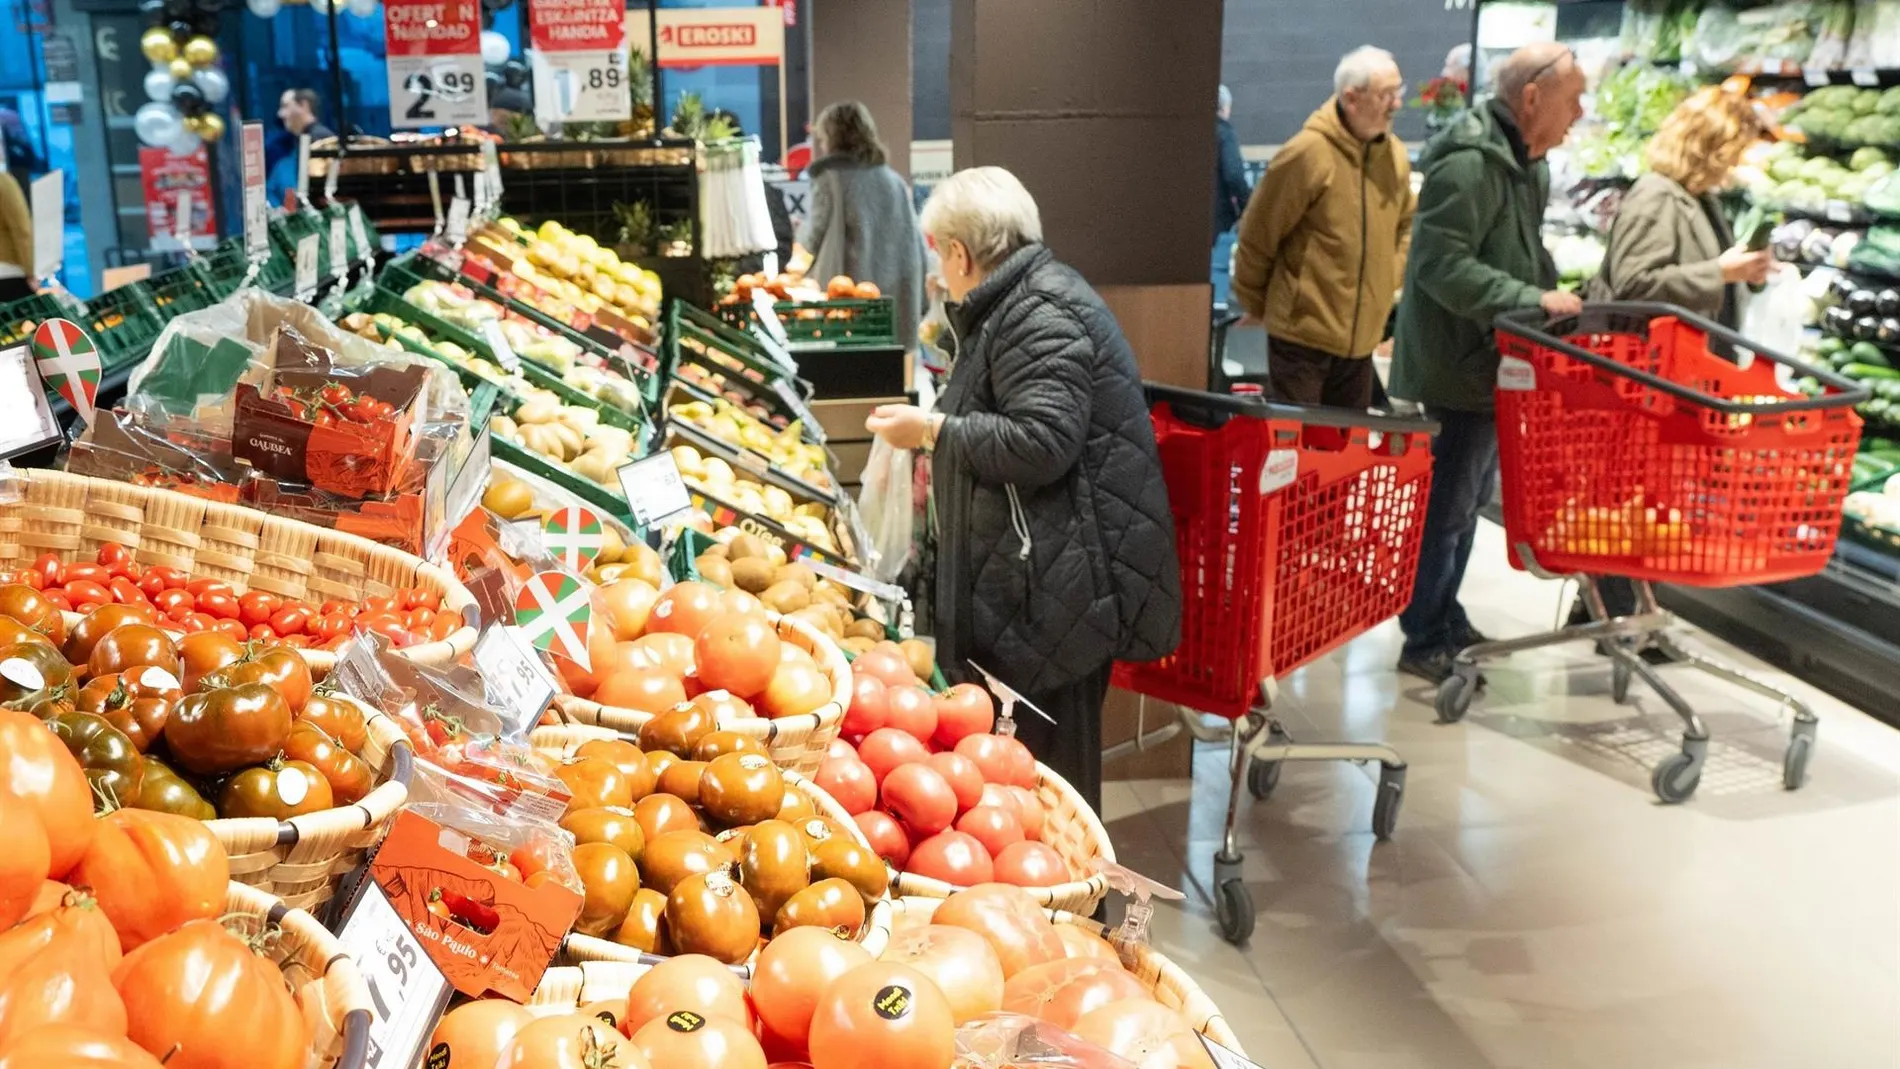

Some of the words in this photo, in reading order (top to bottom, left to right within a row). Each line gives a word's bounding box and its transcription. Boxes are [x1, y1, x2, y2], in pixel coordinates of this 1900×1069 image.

[548, 24, 608, 40] HANDIA
[680, 26, 753, 46] EROSKI
[441, 935, 477, 959] Paulo
